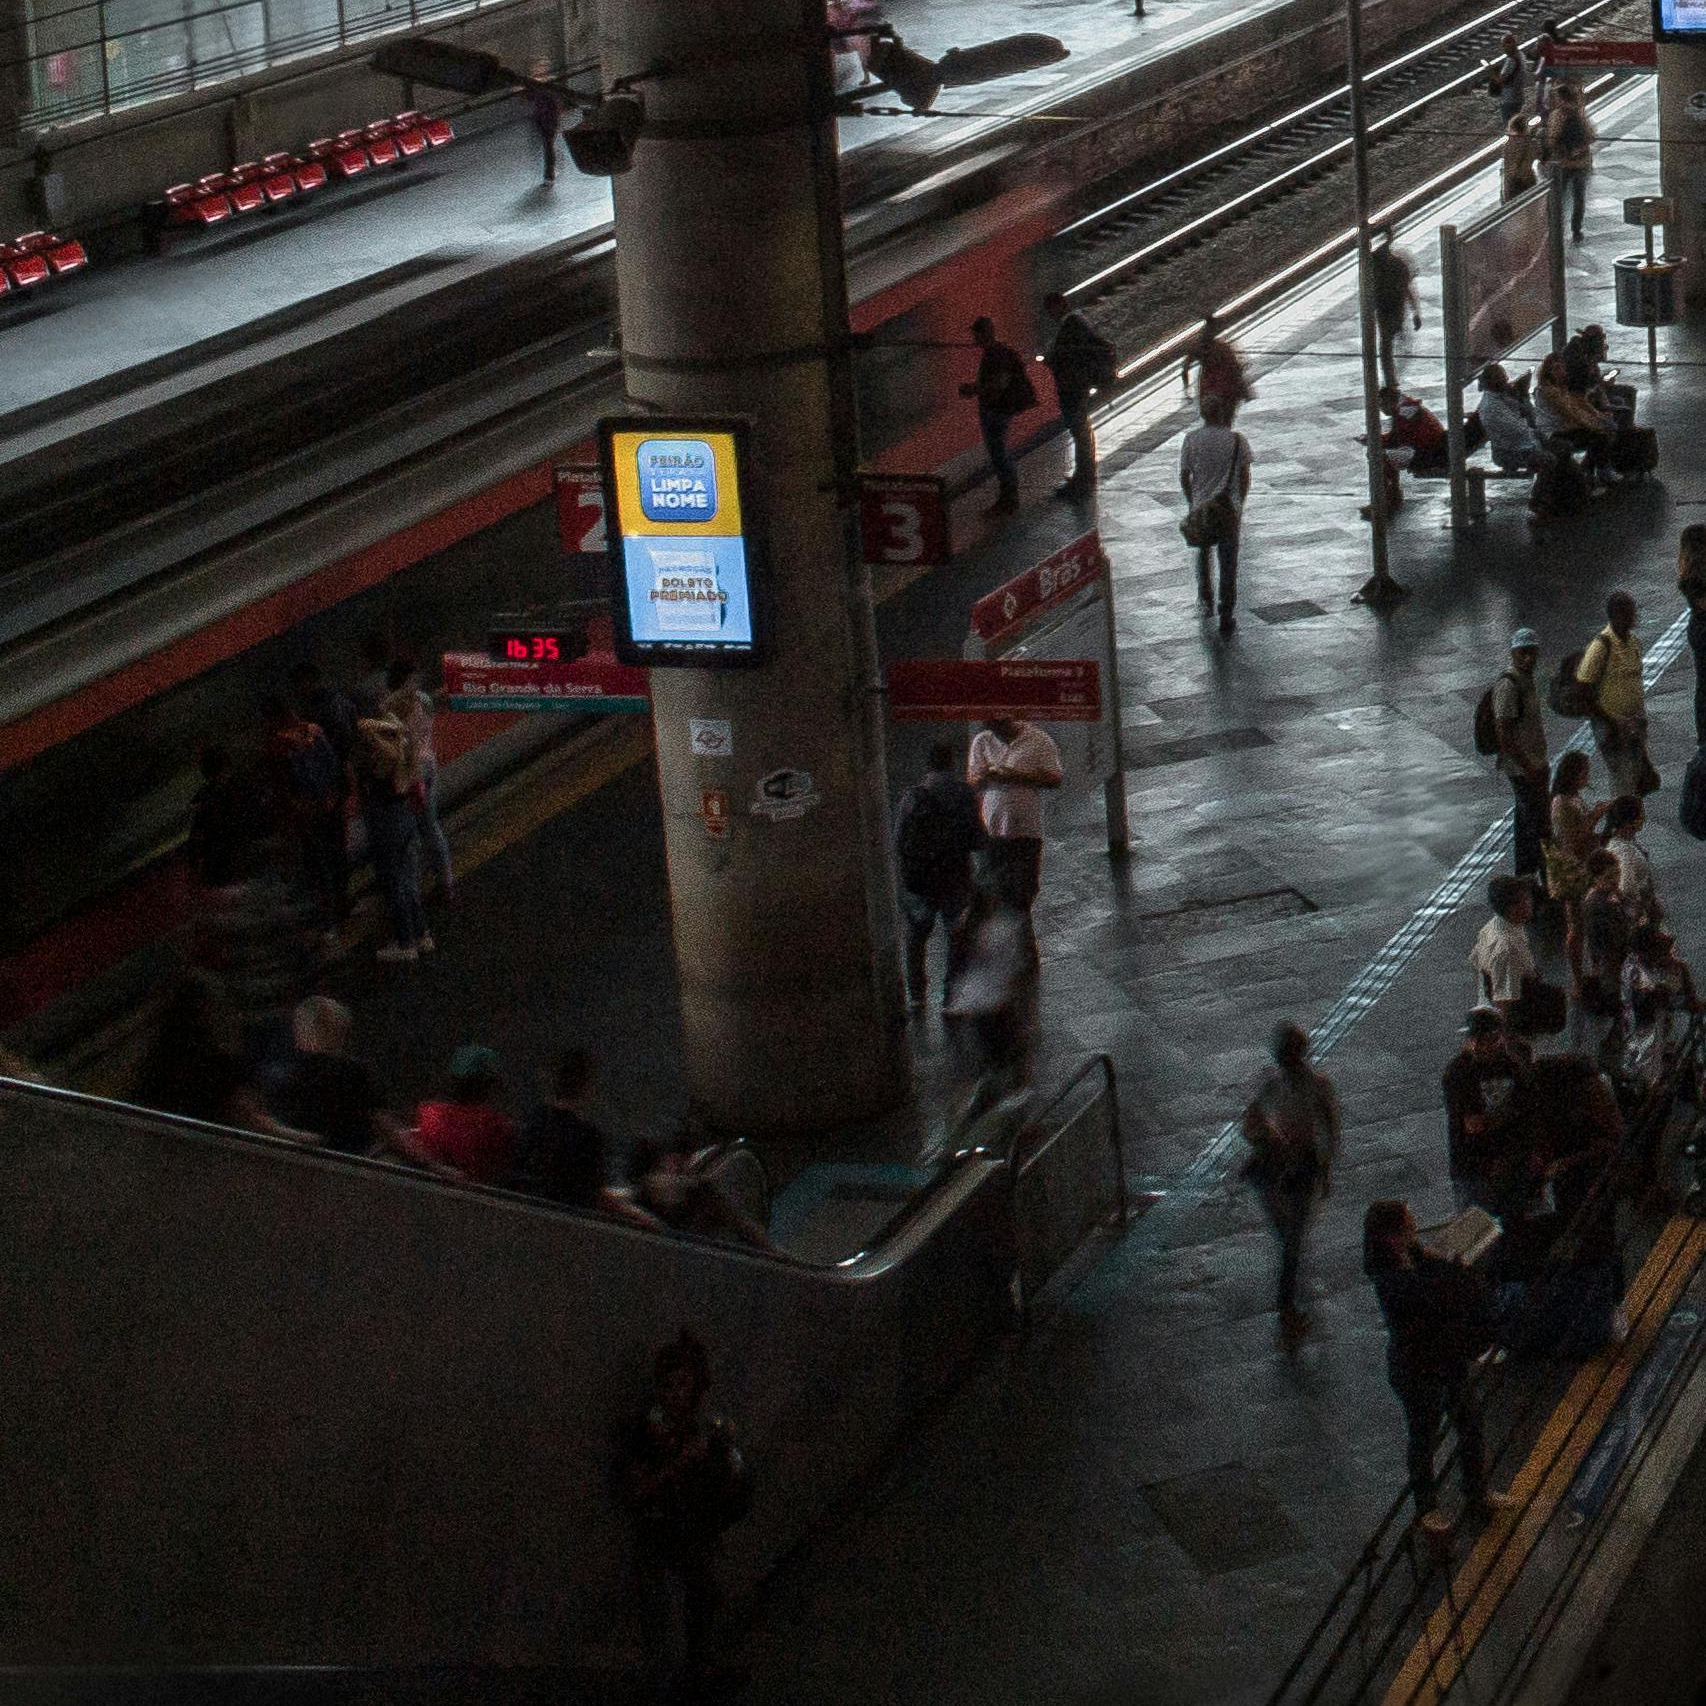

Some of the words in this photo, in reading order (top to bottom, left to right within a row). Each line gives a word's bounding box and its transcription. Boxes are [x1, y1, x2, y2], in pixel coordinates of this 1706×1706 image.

[651, 478, 707, 492] LIMPA
[653, 493, 709, 508] NOME
[578, 492, 609, 552] 2
[881, 501, 924, 562] 3
[662, 577, 714, 588] BOLETO
[463, 683, 487, 694] Rio
[489, 683, 540, 694] Grande
[565, 683, 603, 695] Serra
